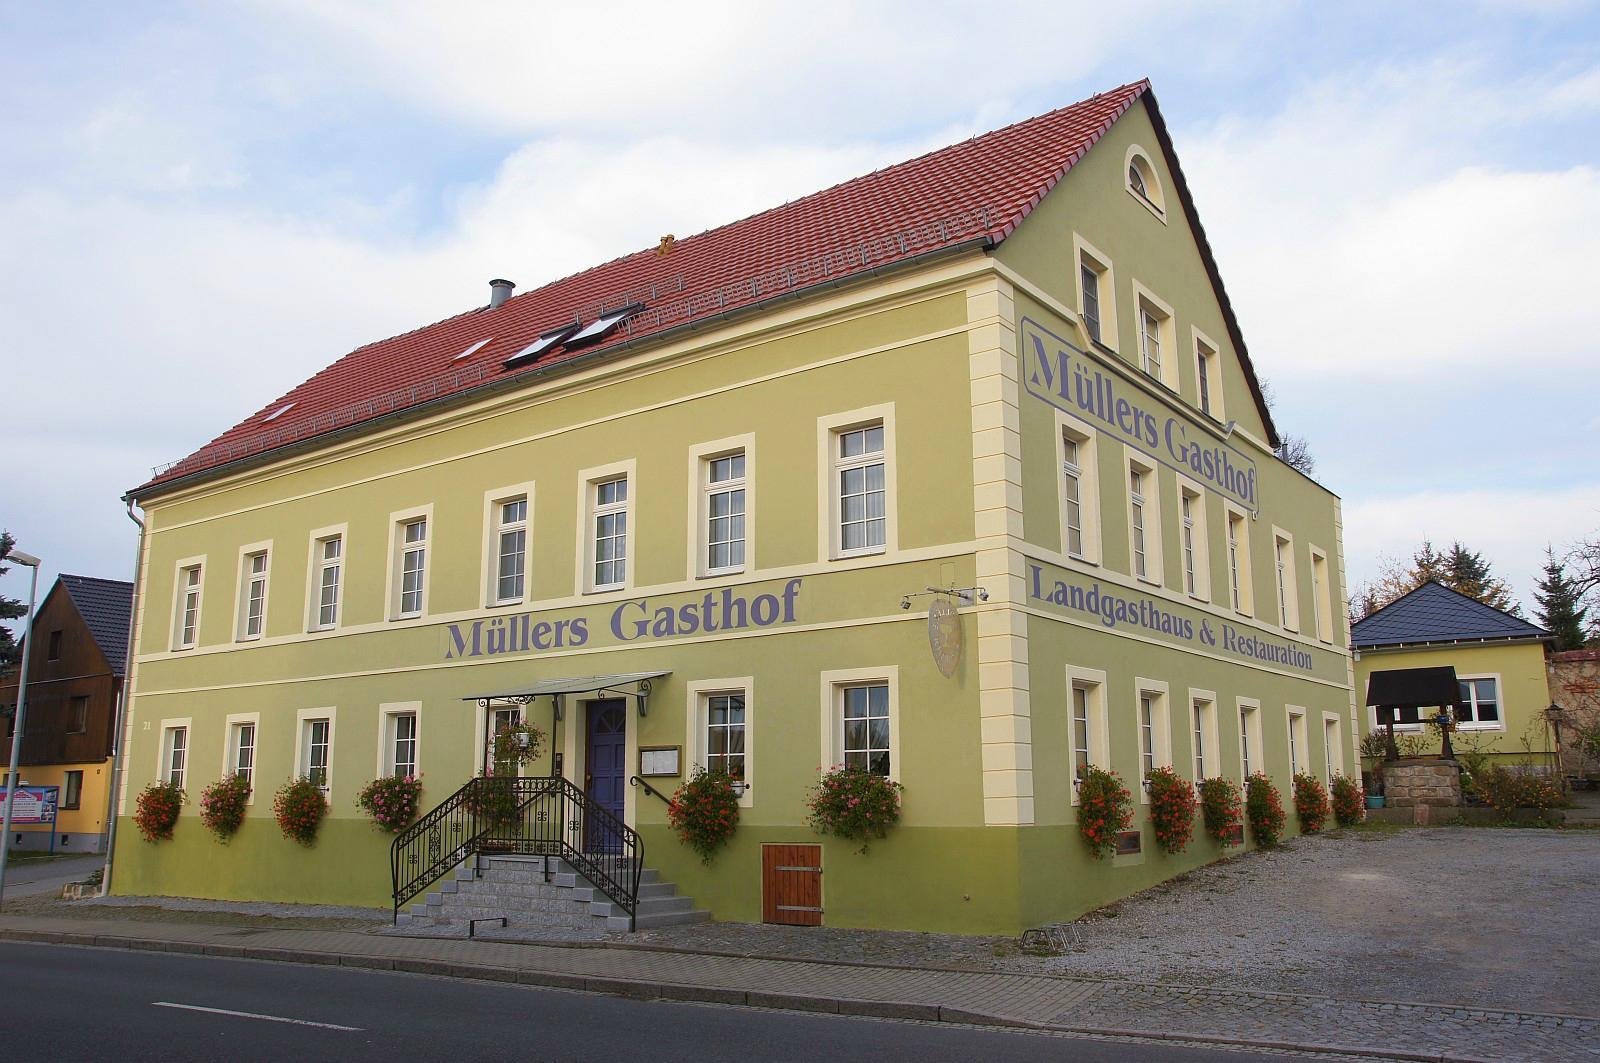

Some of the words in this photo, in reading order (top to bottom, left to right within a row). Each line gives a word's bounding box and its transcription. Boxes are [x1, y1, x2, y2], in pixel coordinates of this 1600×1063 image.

[1028, 331, 1159, 449] Müllers
[1164, 417, 1256, 505] Gasthof
[445, 614, 589, 658] Müllers
[610, 579, 803, 641] Gasthof
[1030, 565, 1194, 641] Landgasthaus
[1199, 618, 1217, 647] &
[1222, 623, 1313, 670] Restauration
